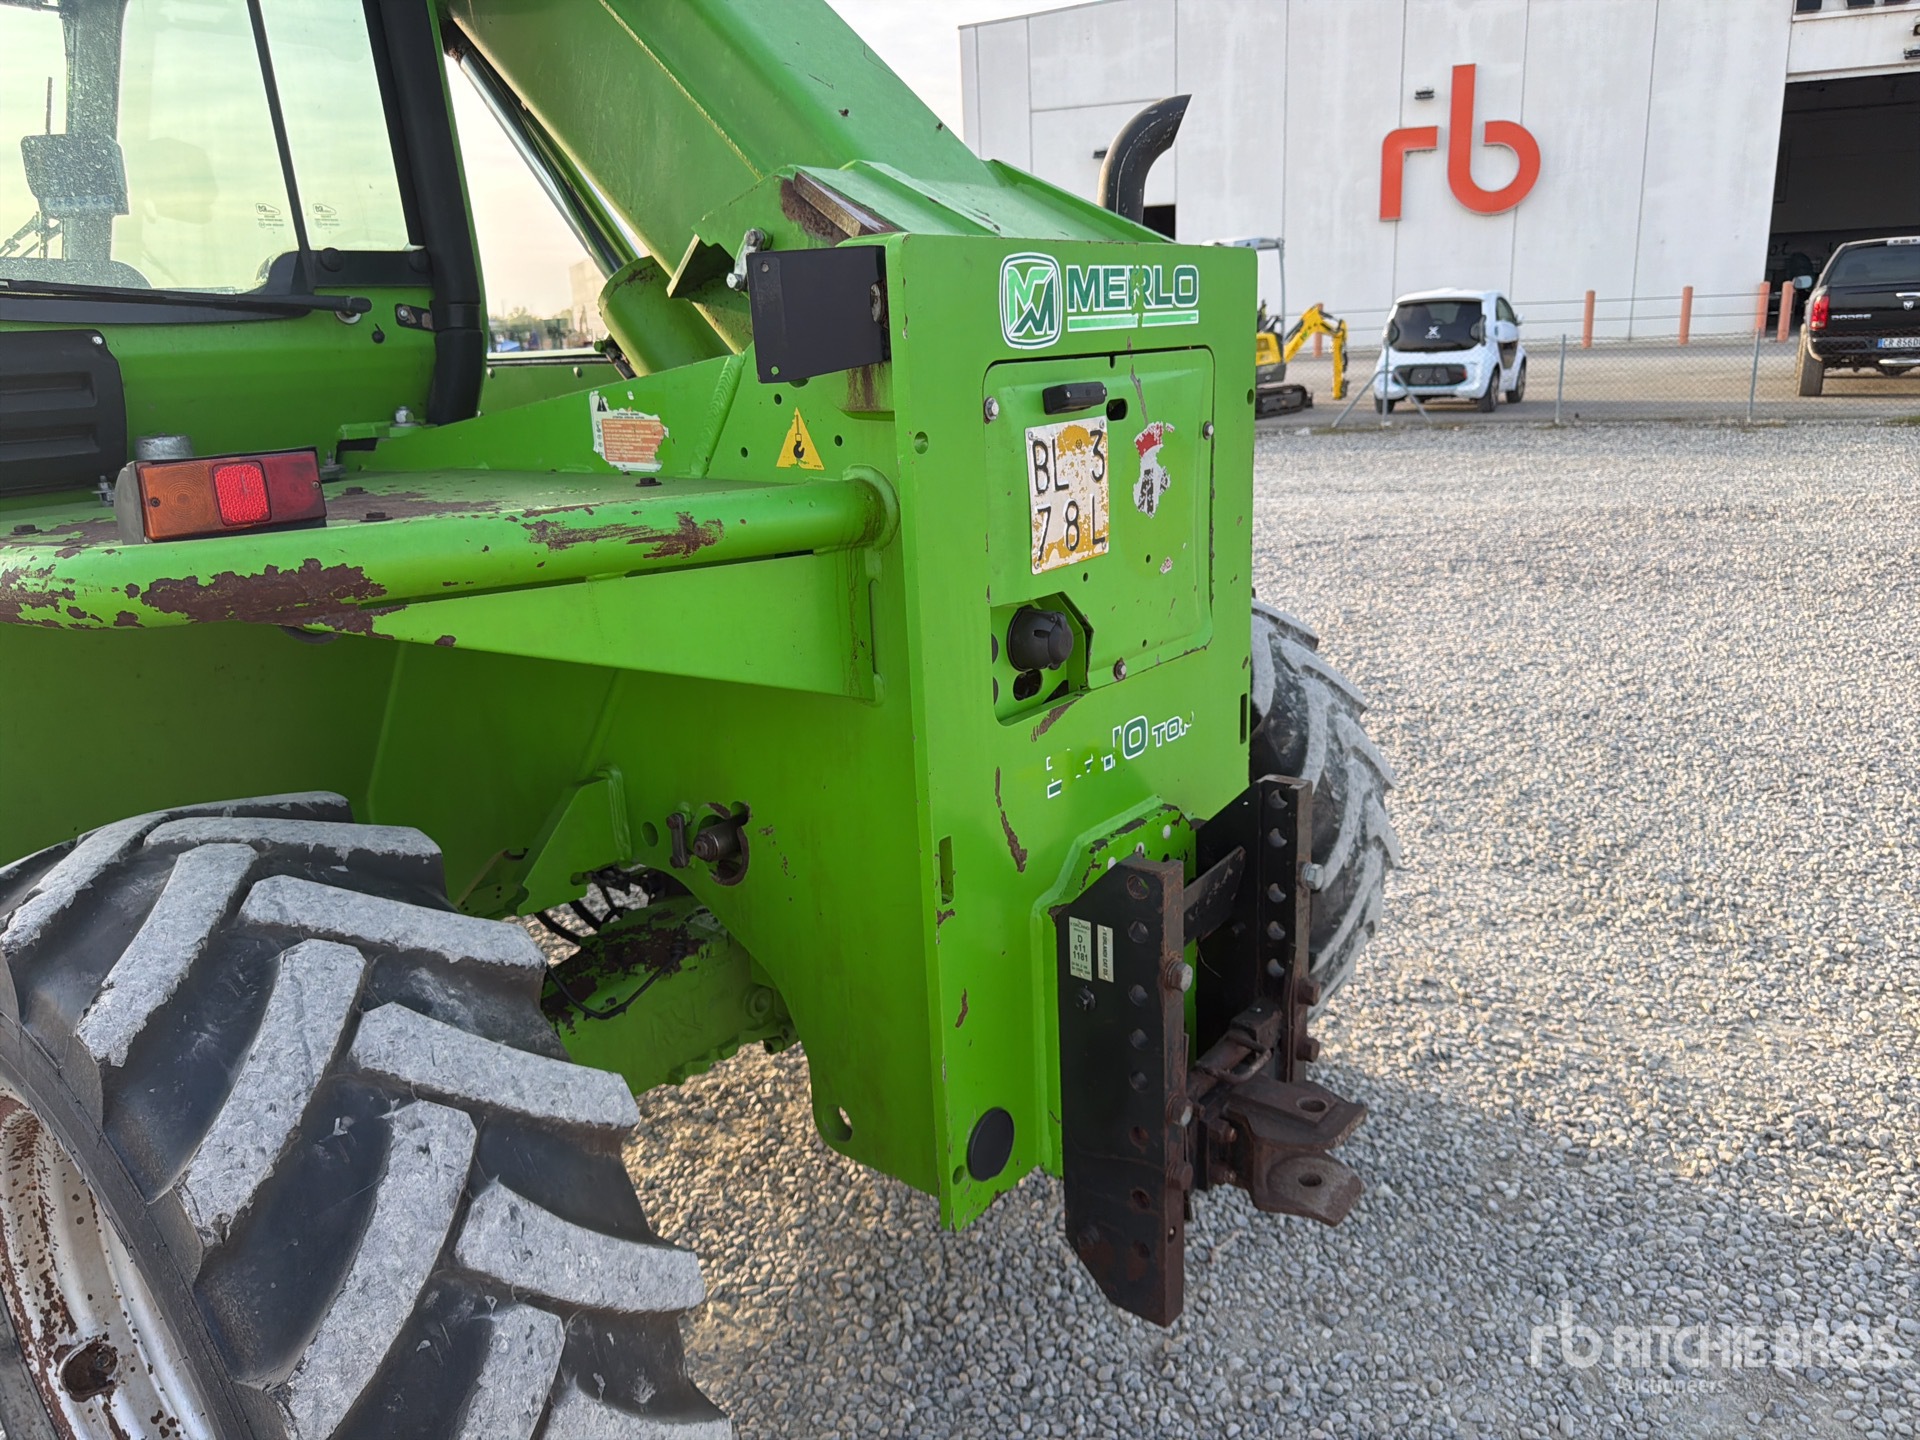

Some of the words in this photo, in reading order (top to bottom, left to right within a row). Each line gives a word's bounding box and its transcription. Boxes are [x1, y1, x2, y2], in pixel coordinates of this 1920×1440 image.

[1379, 63, 1541, 221] rb
[1066, 264, 1199, 312] MERLO
[1077, 935, 1083, 944] D
[1073, 951, 1088, 962] 1181
